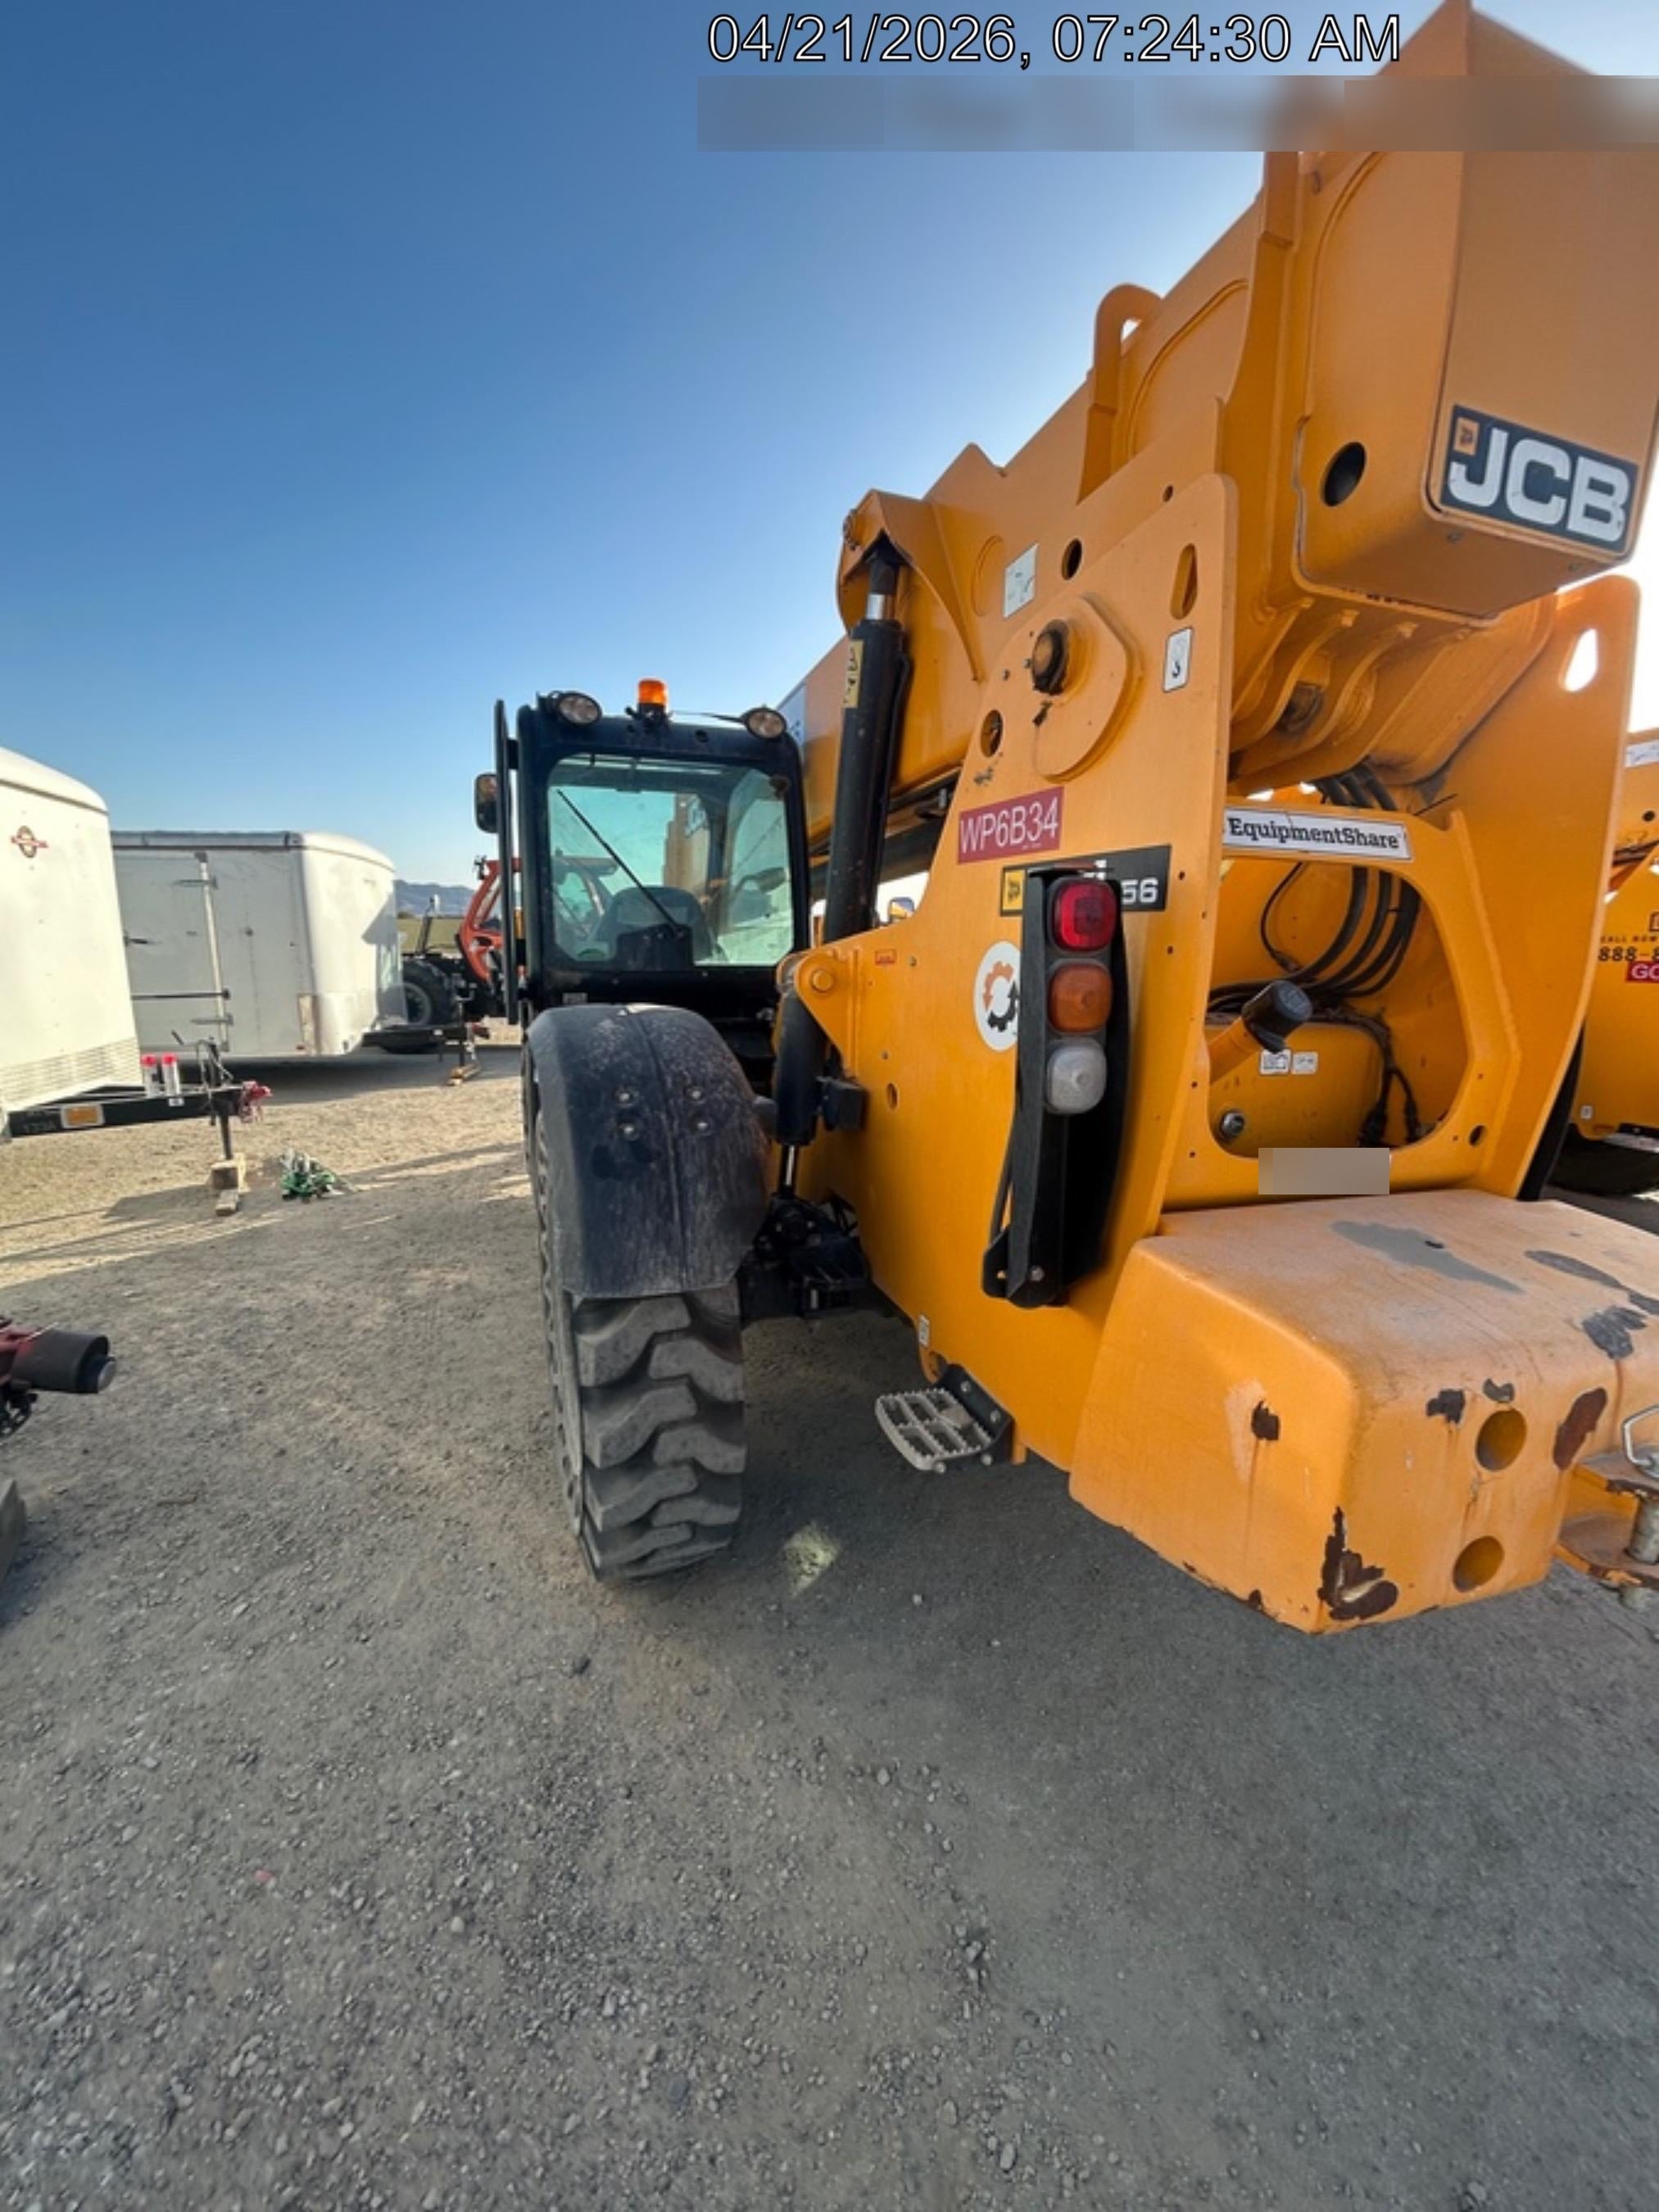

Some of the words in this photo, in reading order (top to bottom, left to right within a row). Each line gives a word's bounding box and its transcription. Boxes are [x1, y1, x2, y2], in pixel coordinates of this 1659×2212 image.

[1448, 427, 1630, 542] JCB
[959, 796, 1058, 854] WP6B34
[1226, 817, 1399, 849] EquipmentShare
